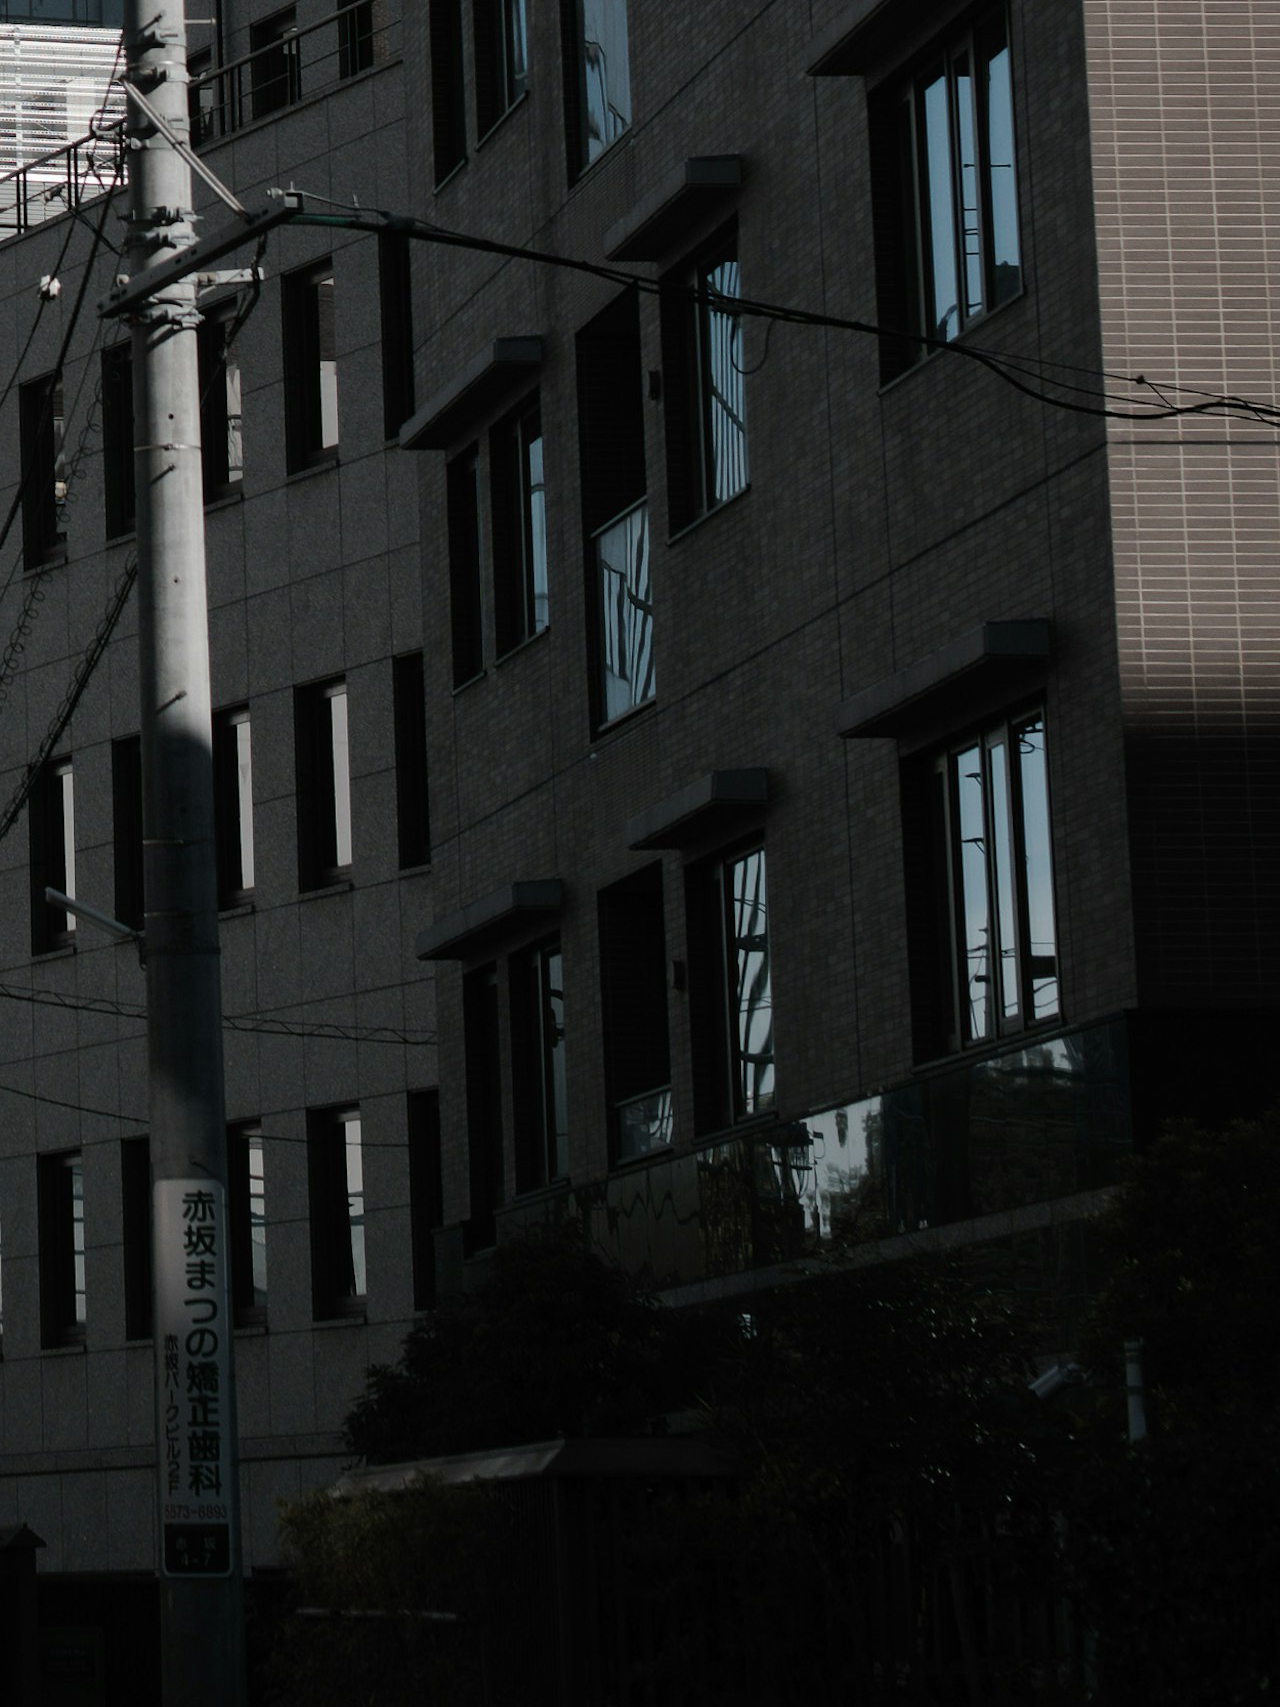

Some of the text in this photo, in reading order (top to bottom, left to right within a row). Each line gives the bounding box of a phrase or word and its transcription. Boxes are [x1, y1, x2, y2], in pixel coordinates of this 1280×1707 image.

[181, 1189, 223, 1497] 赤坂まつの矯正歯科
